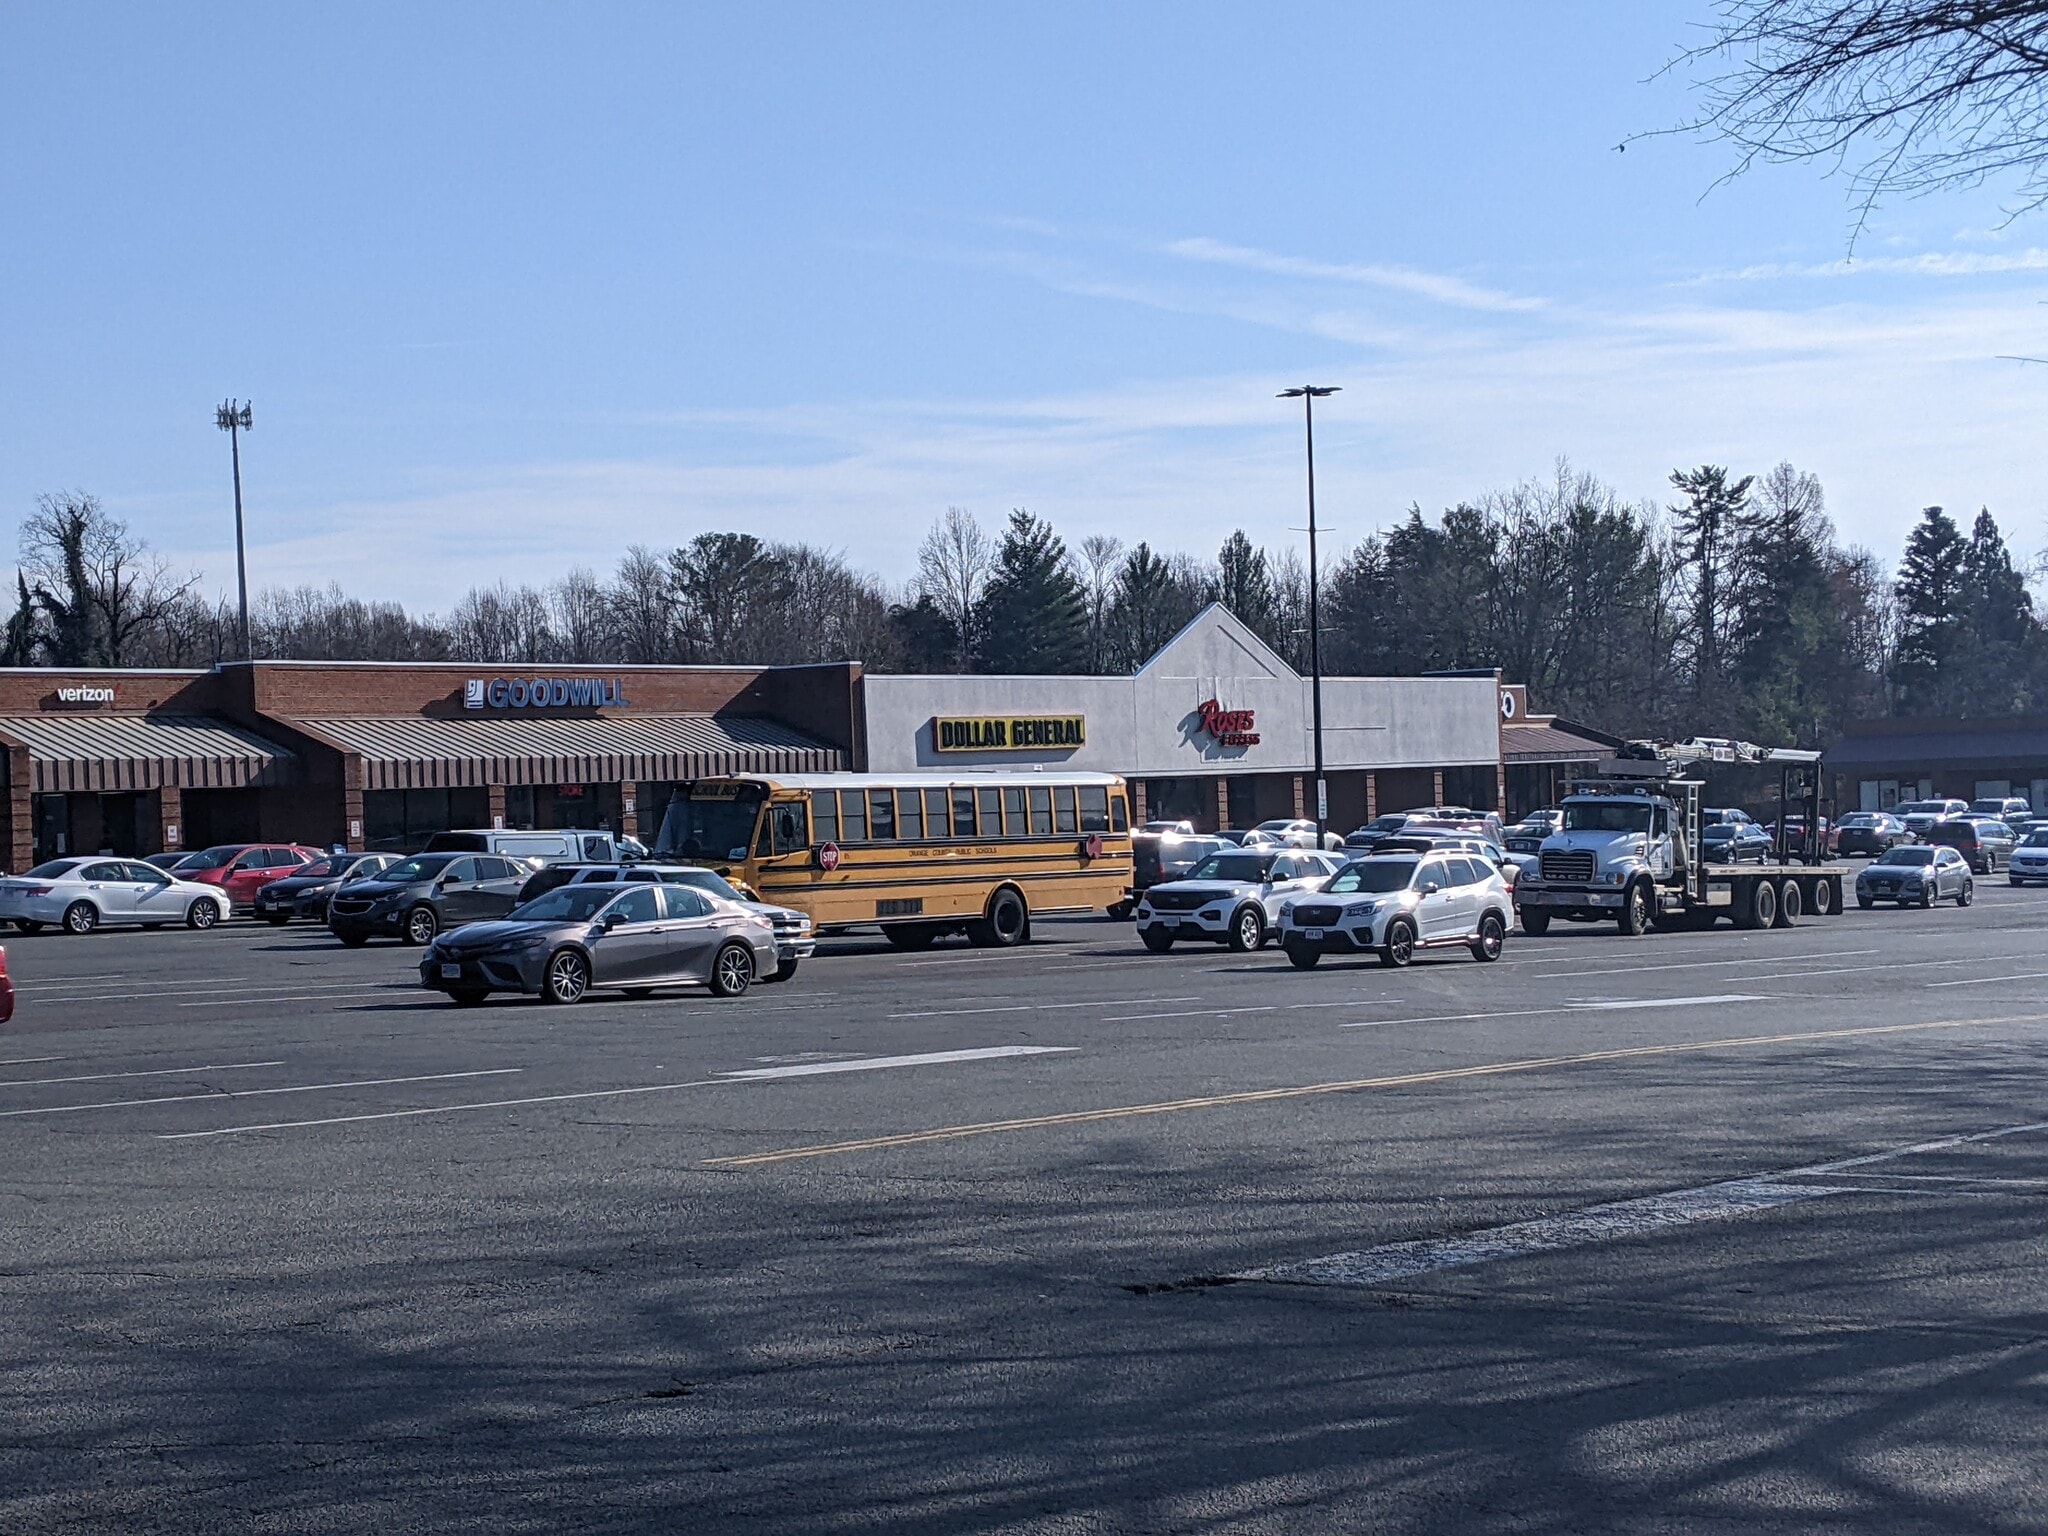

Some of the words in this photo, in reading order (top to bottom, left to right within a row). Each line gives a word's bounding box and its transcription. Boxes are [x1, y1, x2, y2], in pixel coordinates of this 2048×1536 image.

[57, 685, 115, 702] verizon
[488, 679, 630, 707] GOODWILL
[940, 720, 1006, 749] DOLLAR
[1012, 718, 1084, 746] GENERAL
[822, 852, 837, 862] STOP
